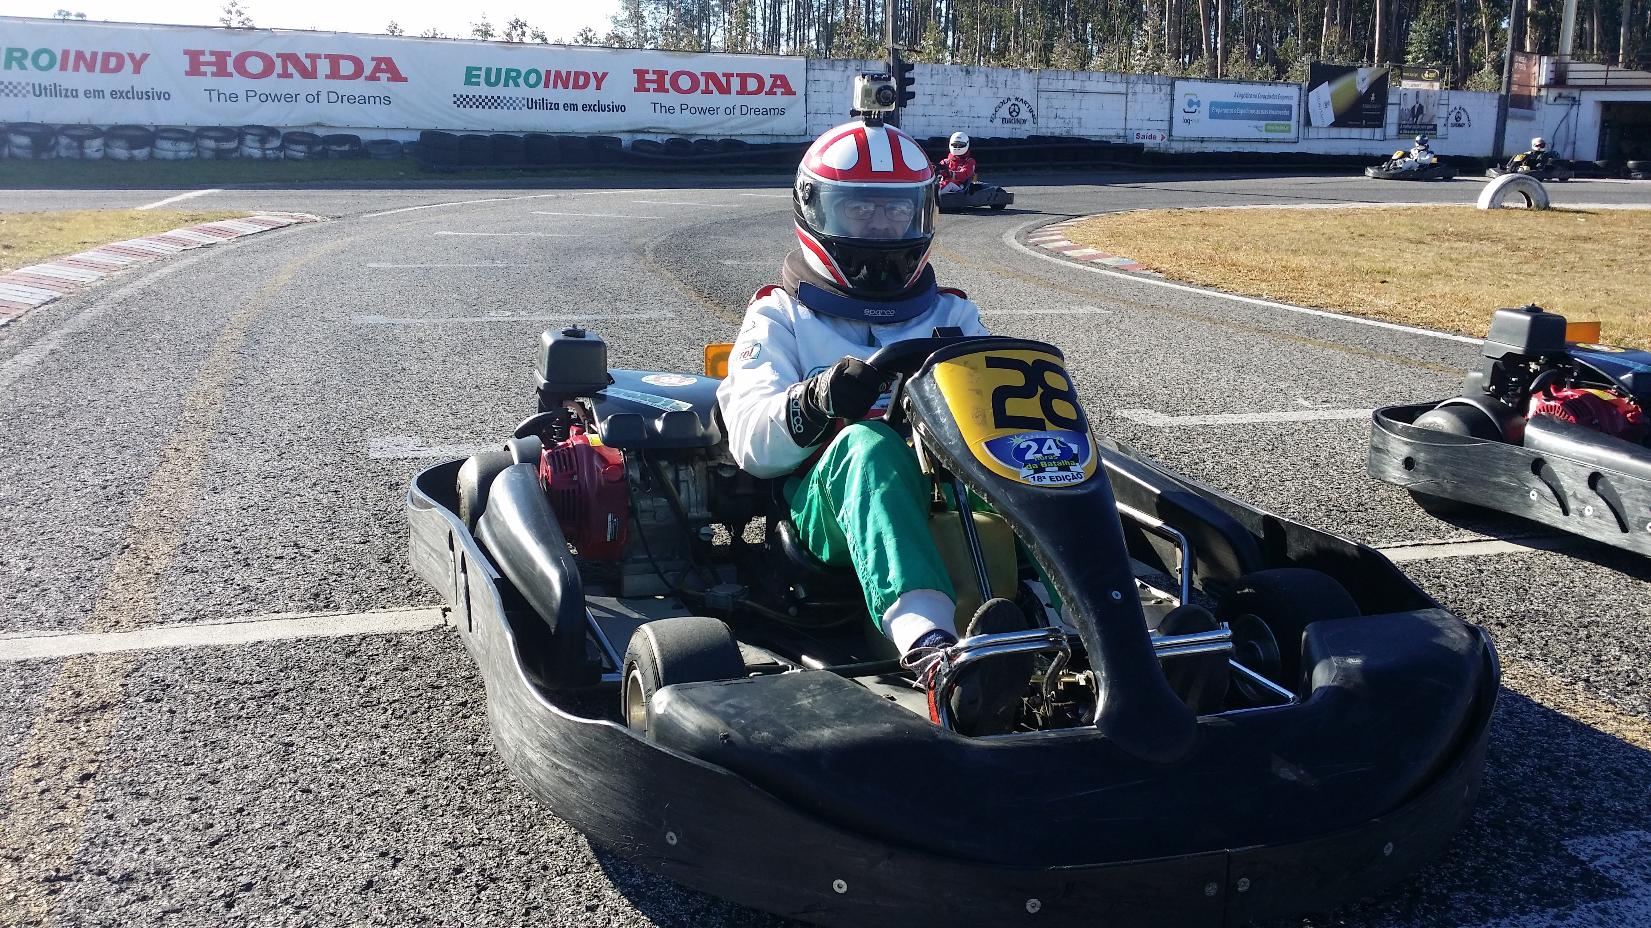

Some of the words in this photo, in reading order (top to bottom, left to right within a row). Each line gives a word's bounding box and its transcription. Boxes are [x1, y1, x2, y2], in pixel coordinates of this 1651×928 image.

[0, 47, 151, 75] ROINDY
[183, 48, 408, 83] HONDA
[463, 65, 609, 91] EUROINDY
[632, 68, 796, 96] HONDA
[31, 82, 79, 99] Utiliza
[84, 88, 105, 100] em
[110, 85, 171, 102] exclusivo
[204, 88, 239, 103] The
[245, 89, 300, 105] Power
[305, 89, 321, 104] of
[327, 90, 392, 106] Dreams
[526, 97, 560, 111] Utiliza
[563, 102, 579, 113] em
[581, 99, 627, 114] exclusivo
[650, 102, 675, 115] The
[680, 103, 721, 117] Power
[724, 103, 737, 116] of
[741, 104, 786, 117] Dreams
[984, 355, 1088, 434] 28
[1019, 438, 1062, 461] 24
[1040, 459, 1077, 469] Batalha
[1049, 473, 1084, 483] EDIÇÃO
